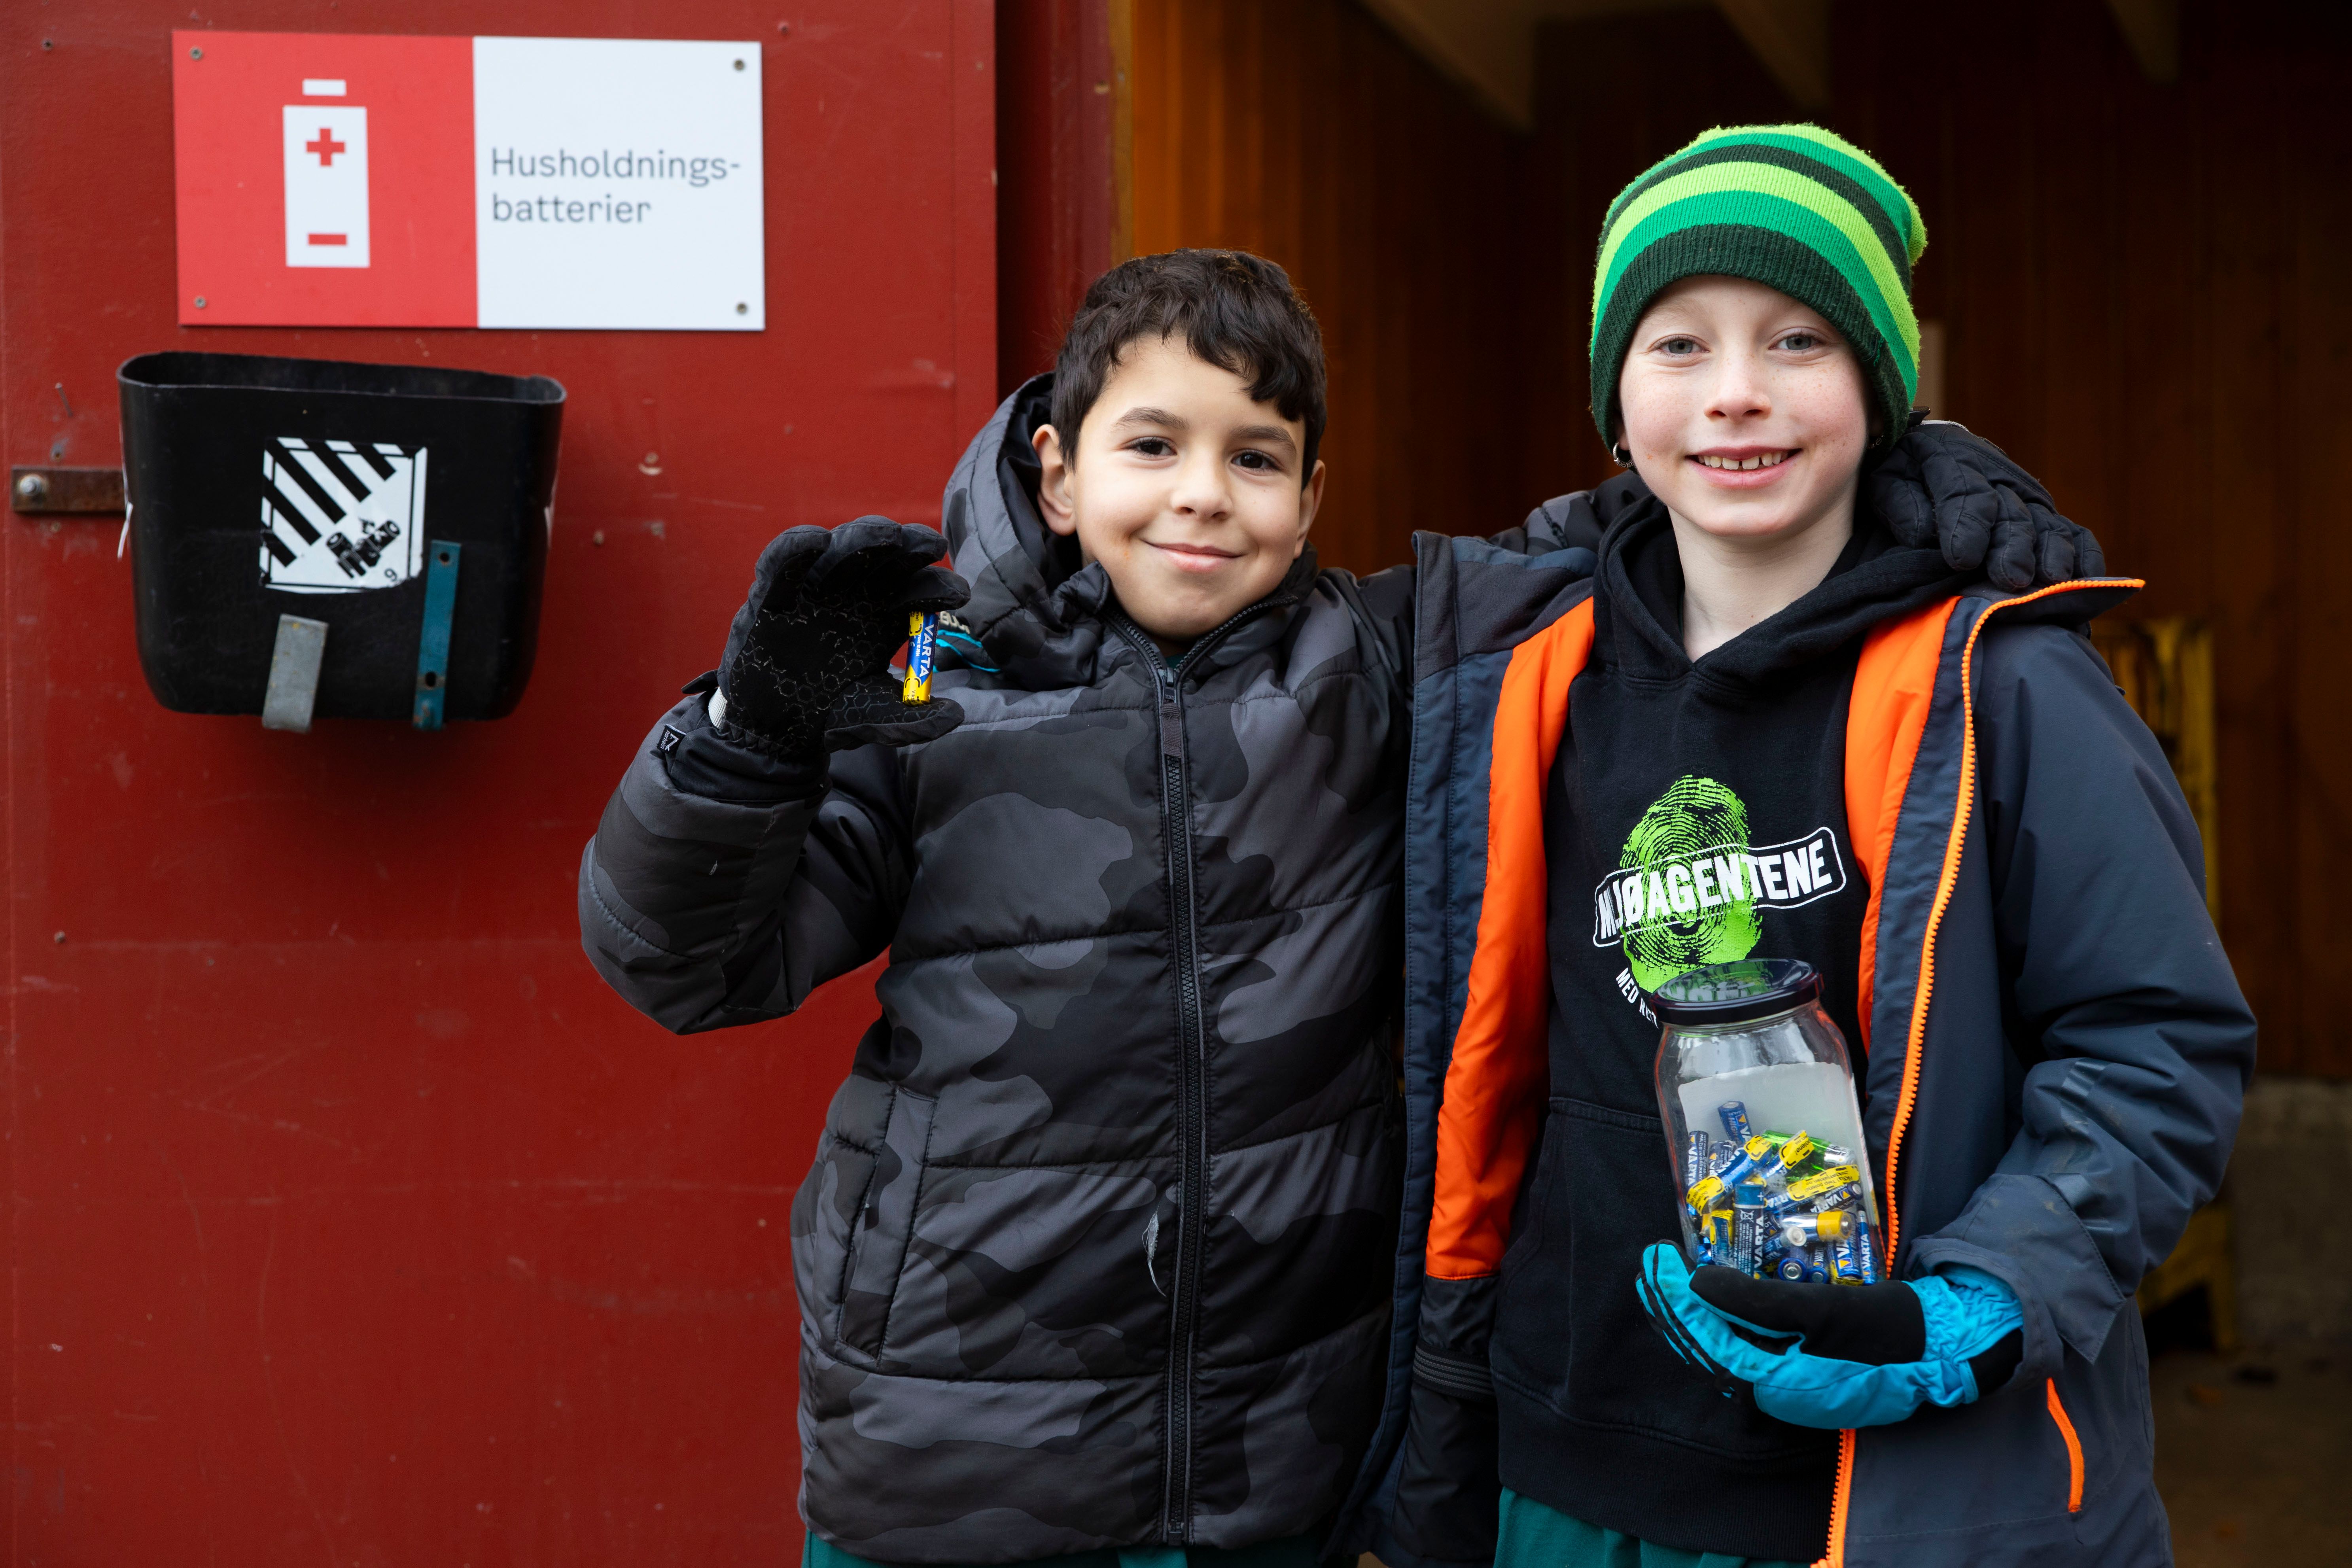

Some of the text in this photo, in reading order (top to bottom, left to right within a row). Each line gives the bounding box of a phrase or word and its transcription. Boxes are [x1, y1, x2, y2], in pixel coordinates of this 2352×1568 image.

[492, 148, 740, 187] Husholdnings-
[493, 193, 651, 223] batterier
[919, 624, 934, 677] VARTA
[1616, 968, 1639, 1003] MED
[1688, 1146, 1698, 1186] VARTA
[1754, 1215, 1764, 1268] VARTA
[1860, 1234, 1870, 1269] VARTA
